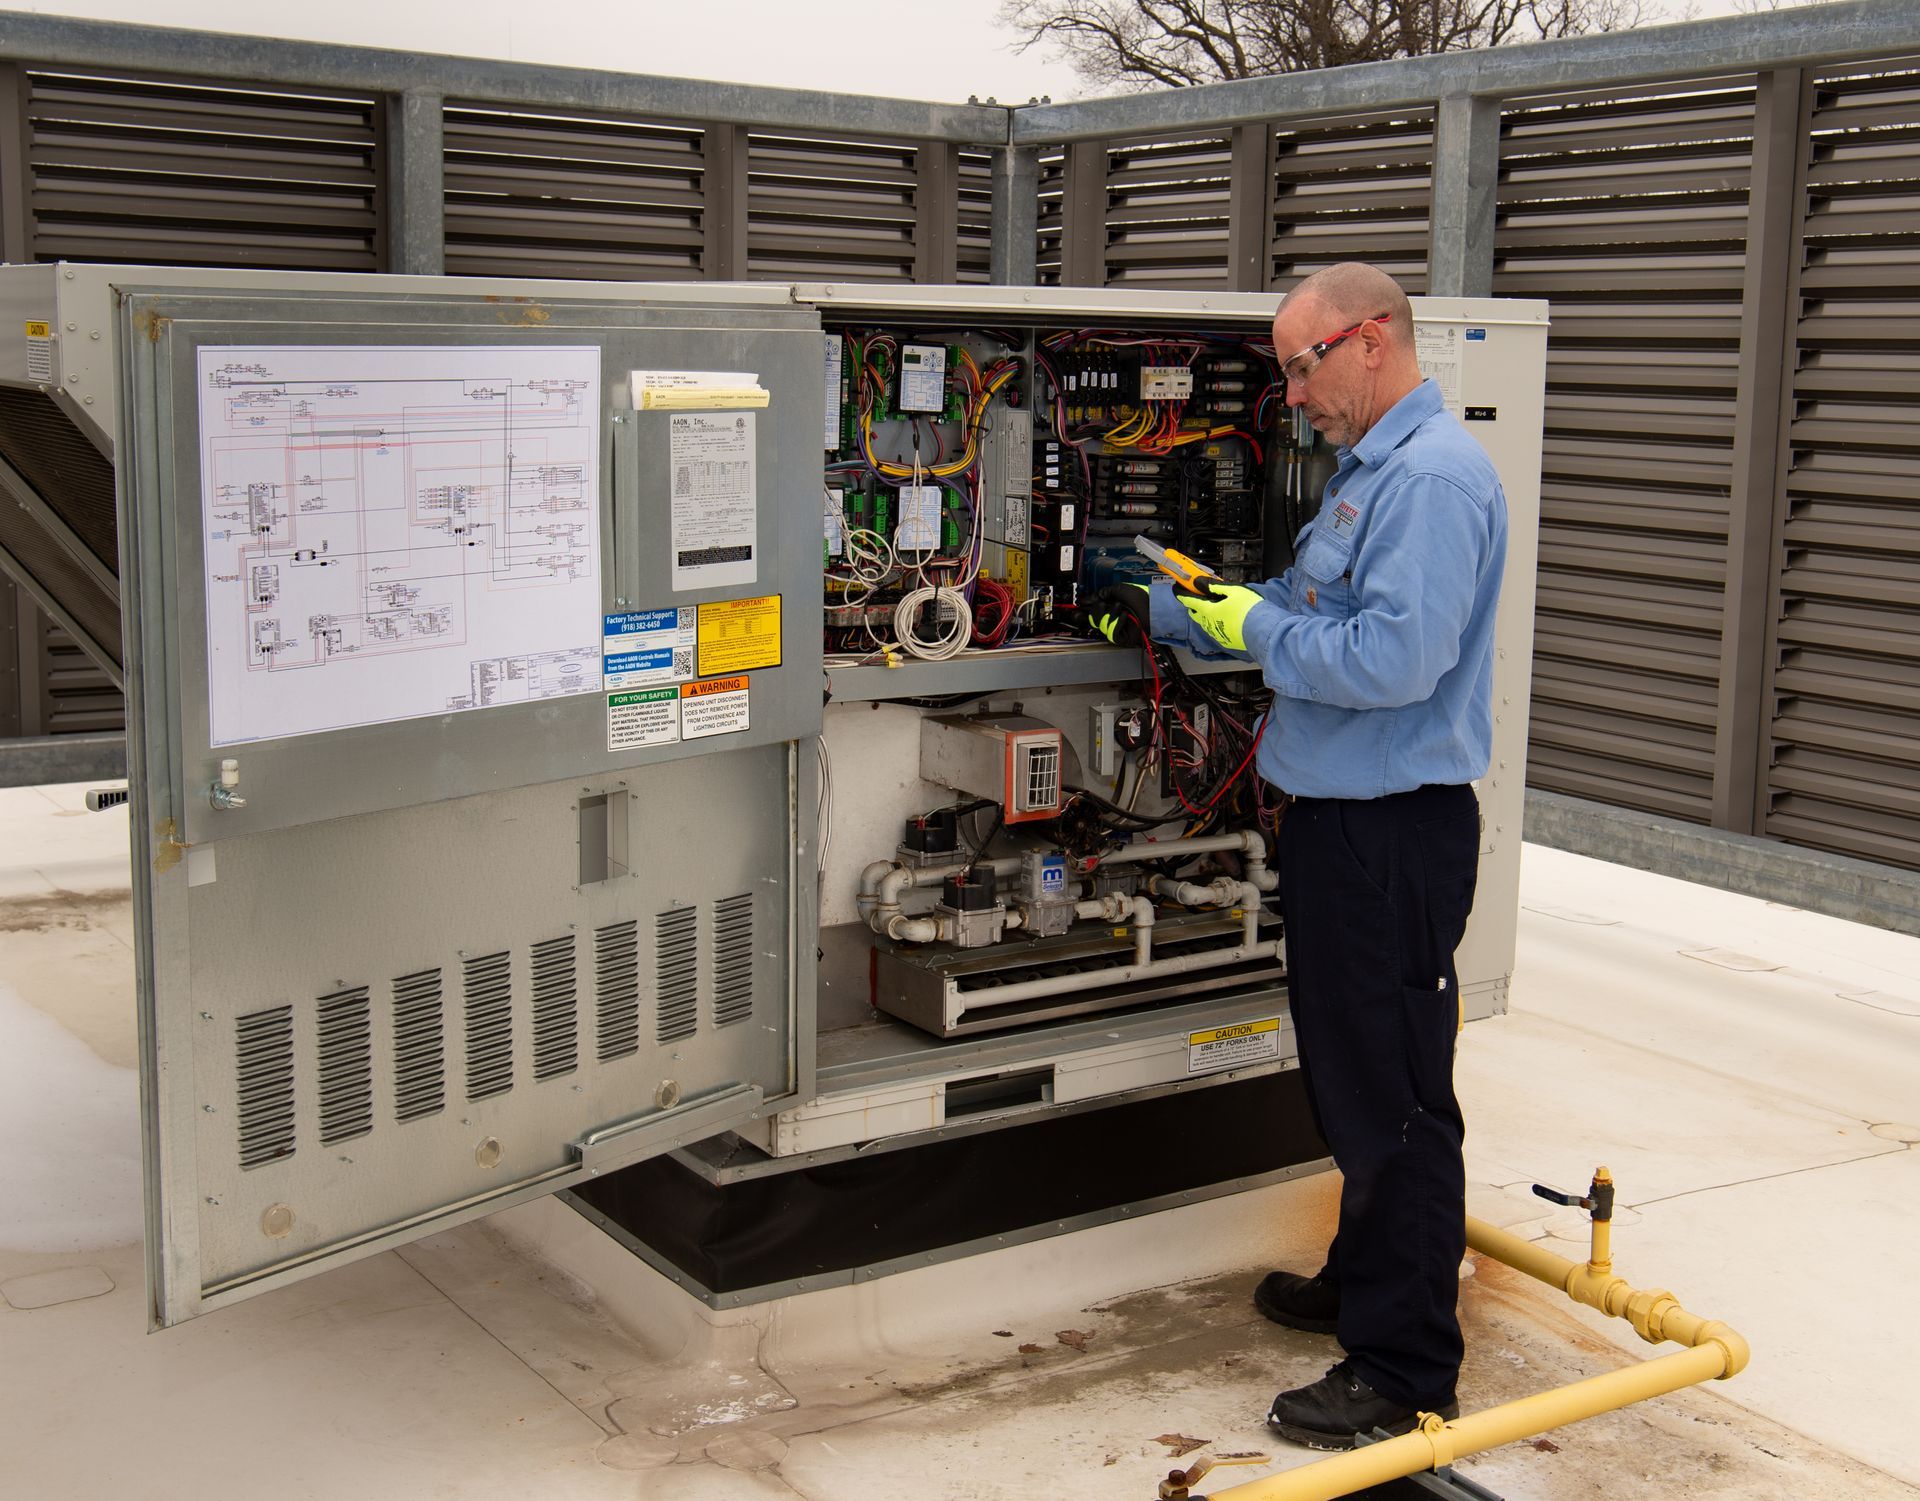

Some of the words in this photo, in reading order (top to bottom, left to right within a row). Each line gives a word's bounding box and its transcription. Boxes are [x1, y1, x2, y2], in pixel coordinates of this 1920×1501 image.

[627, 613, 652, 621] Technical
[652, 611, 674, 619] Support:
[621, 623, 635, 632] (918)
[636, 621, 660, 630] 382-6450
[699, 679, 740, 693] WARNING
[649, 691, 672, 699] SAFETY
[718, 694, 747, 703] DISCONNECT
[702, 713, 734, 722] CONVENIENCE
[694, 723, 715, 731] LIGHTING
[1216, 1026, 1252, 1038] CAUTION
[1226, 1037, 1247, 1047] FORKS
[1249, 1034, 1266, 1042] ONLY
